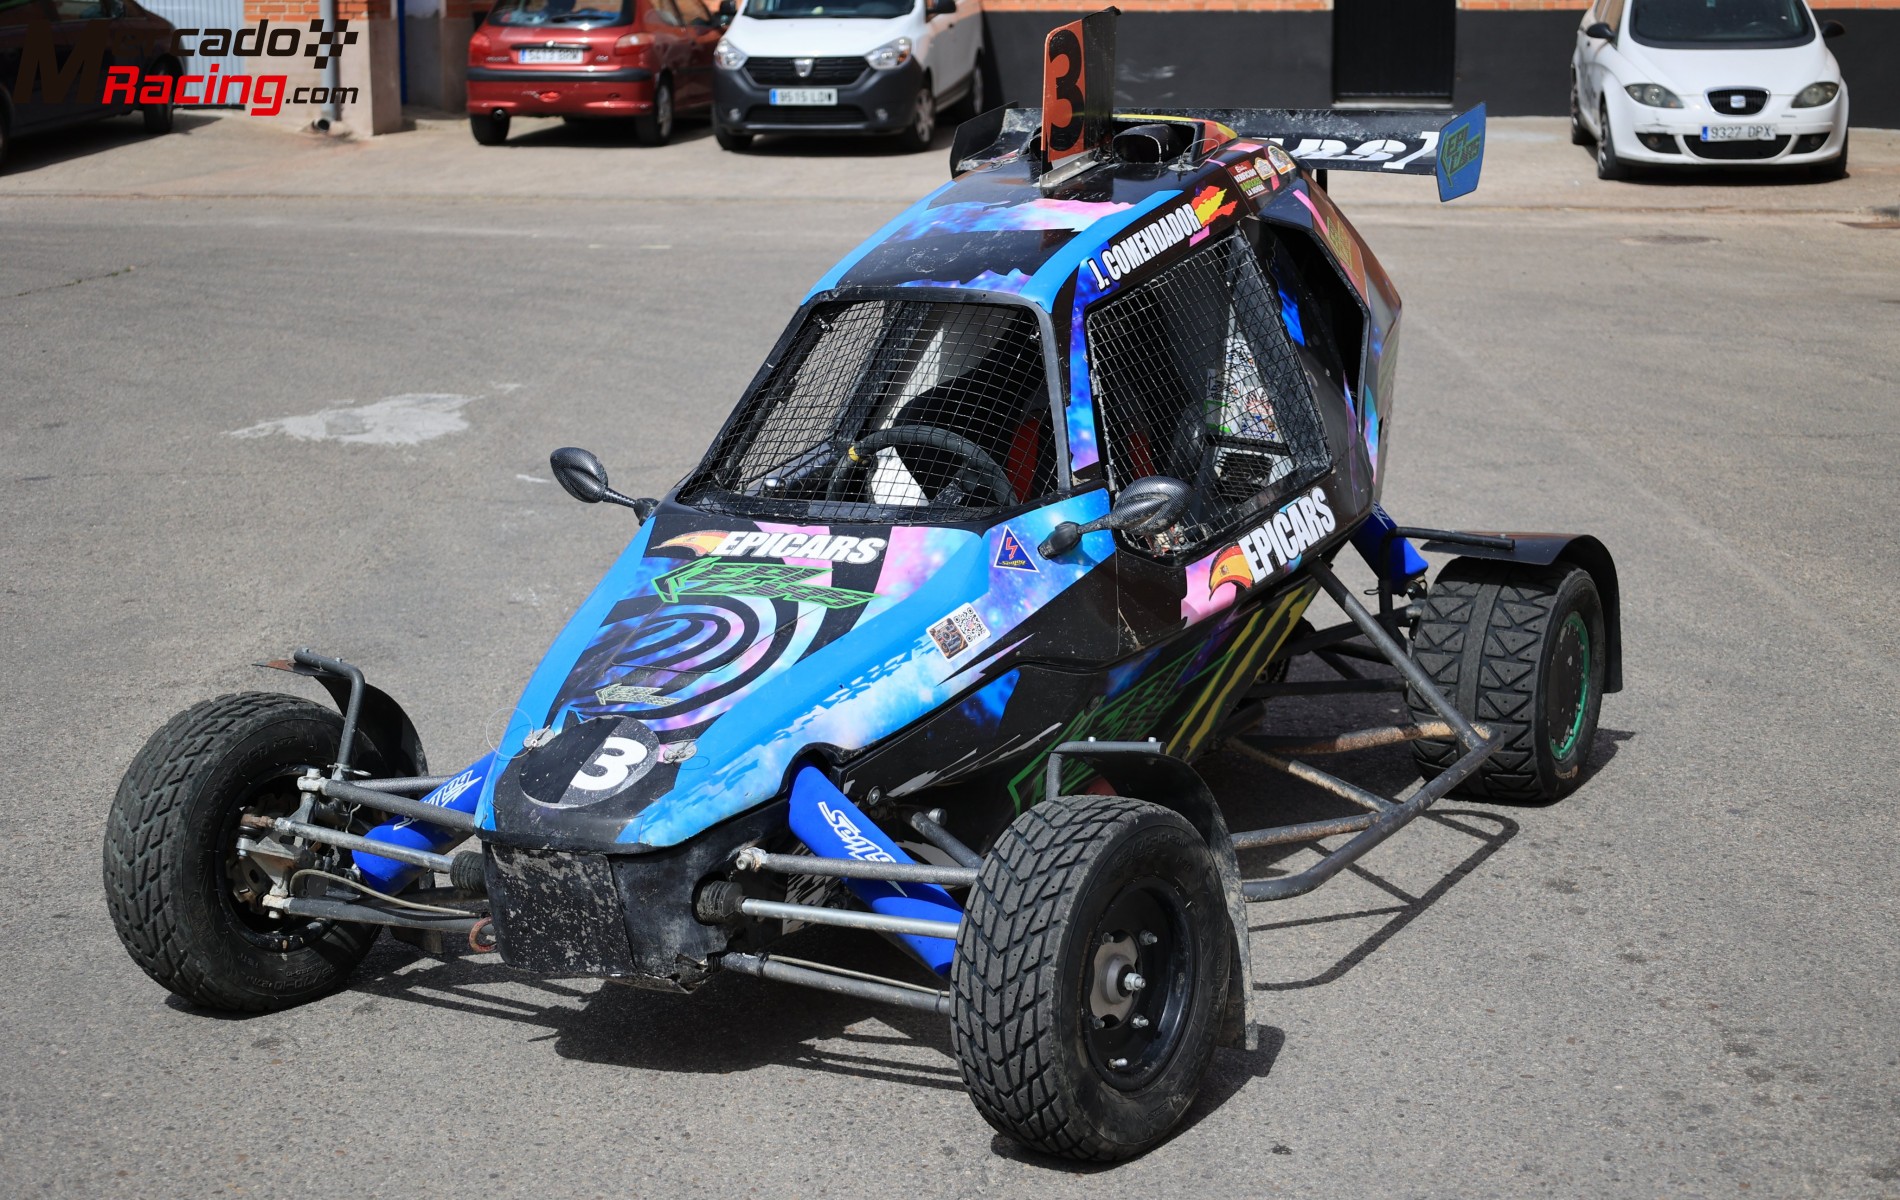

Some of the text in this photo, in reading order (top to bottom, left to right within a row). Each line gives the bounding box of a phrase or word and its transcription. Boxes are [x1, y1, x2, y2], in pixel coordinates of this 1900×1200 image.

[1048, 29, 1085, 151] 3
[1711, 126, 1772, 139] 9327 DPX
[1087, 203, 1202, 291] J. COMENDADOR
[709, 530, 888, 564] EPICARS
[1237, 486, 1337, 584] EPICARS
[569, 736, 648, 791] 3
